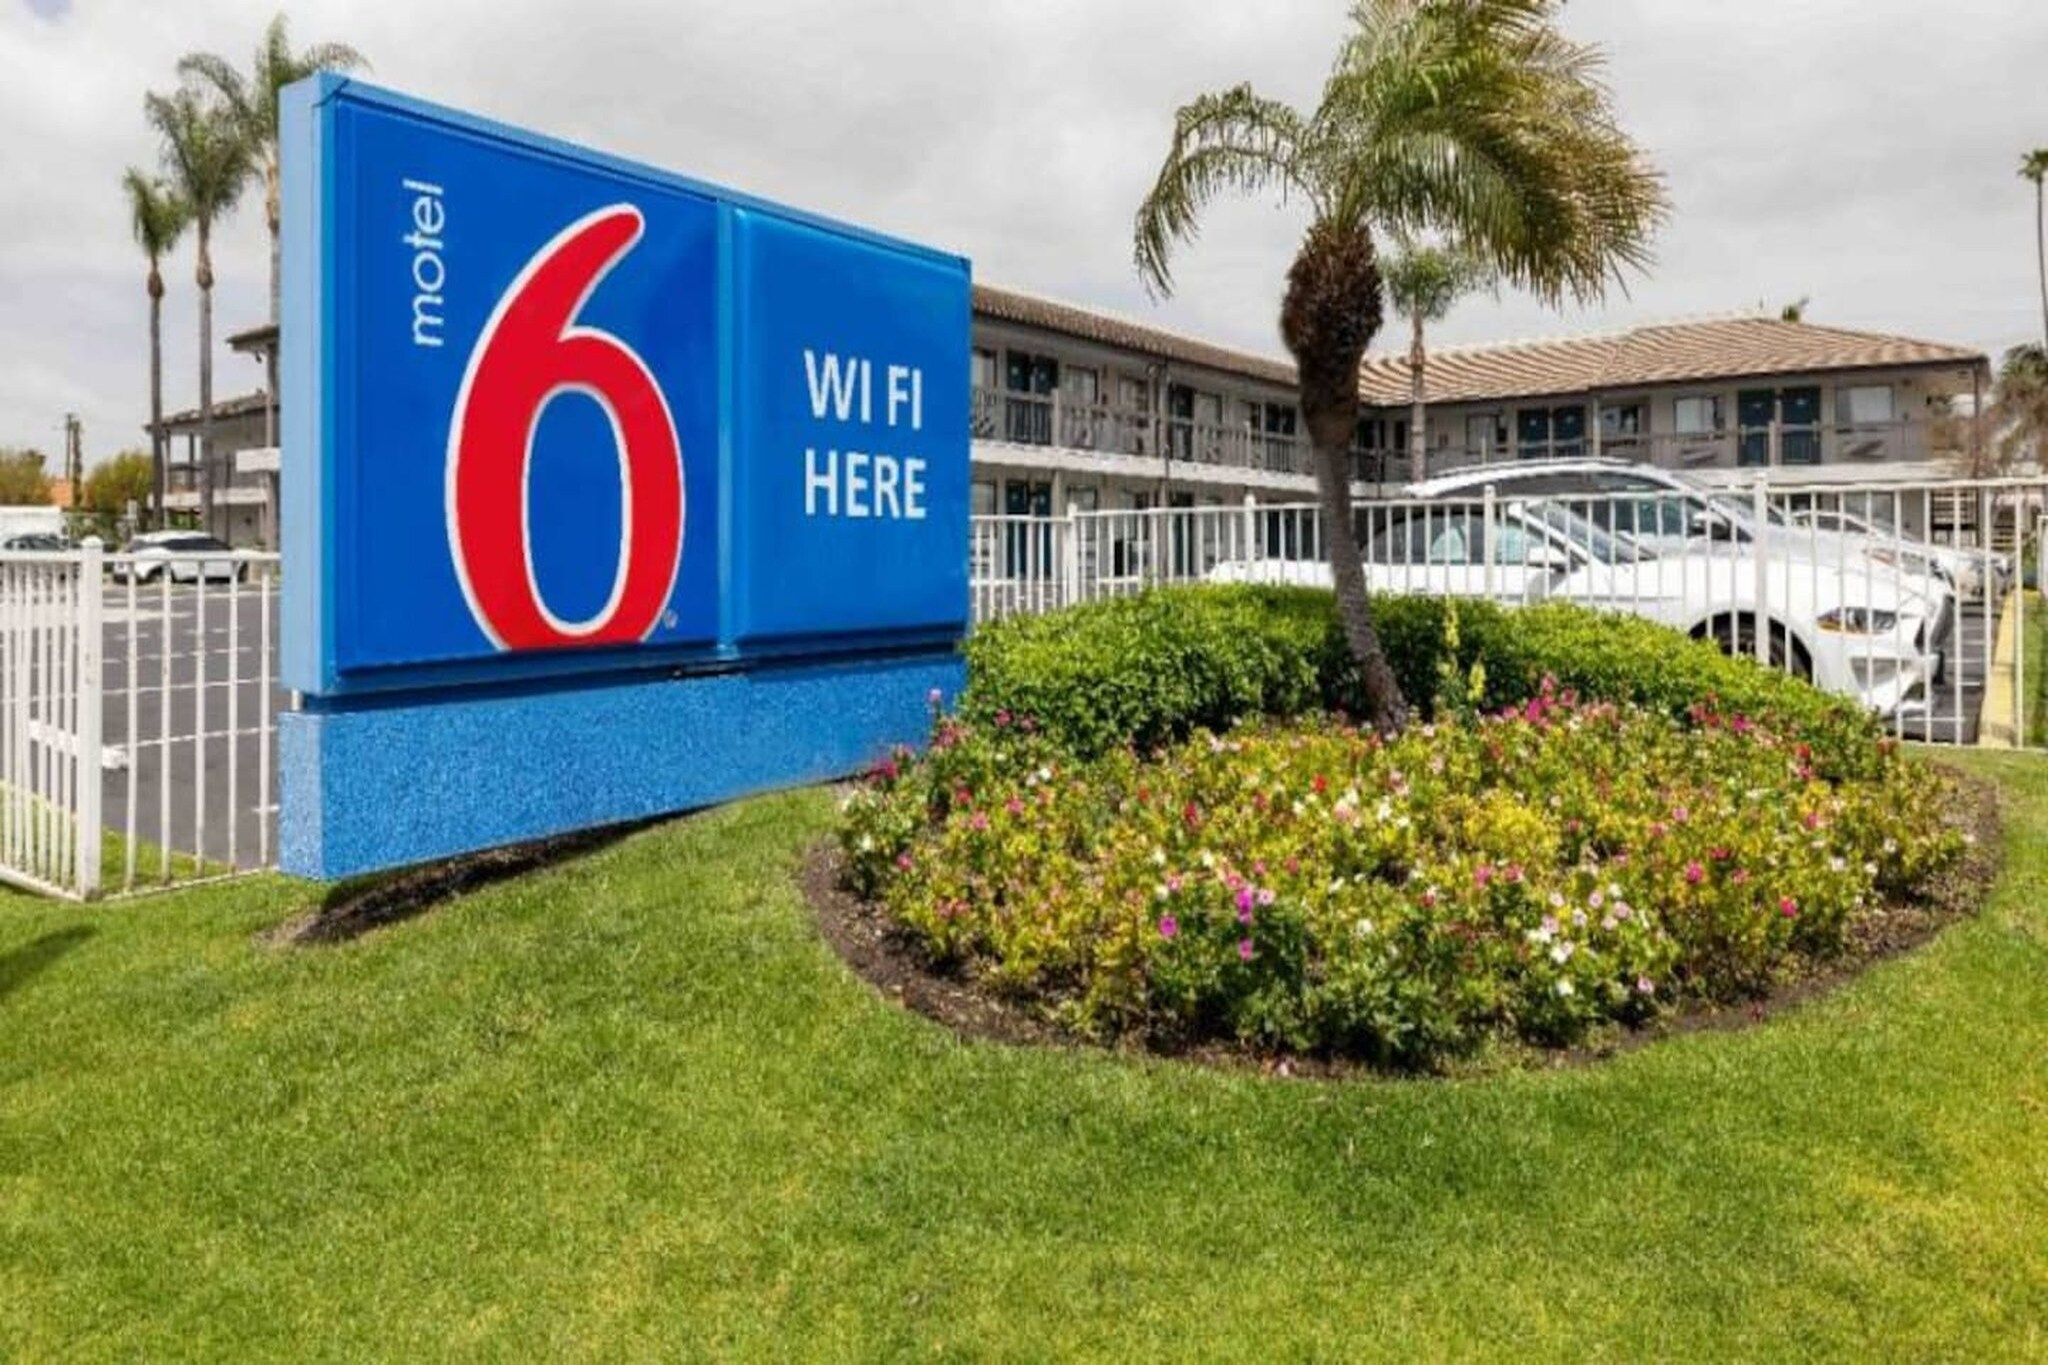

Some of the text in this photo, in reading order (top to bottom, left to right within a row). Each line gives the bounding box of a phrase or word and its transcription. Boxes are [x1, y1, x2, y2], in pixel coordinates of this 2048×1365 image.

[403, 180, 445, 347] motel
[445, 202, 686, 651] 6
[804, 350, 922, 430] WI FI
[805, 448, 927, 519] HERE
